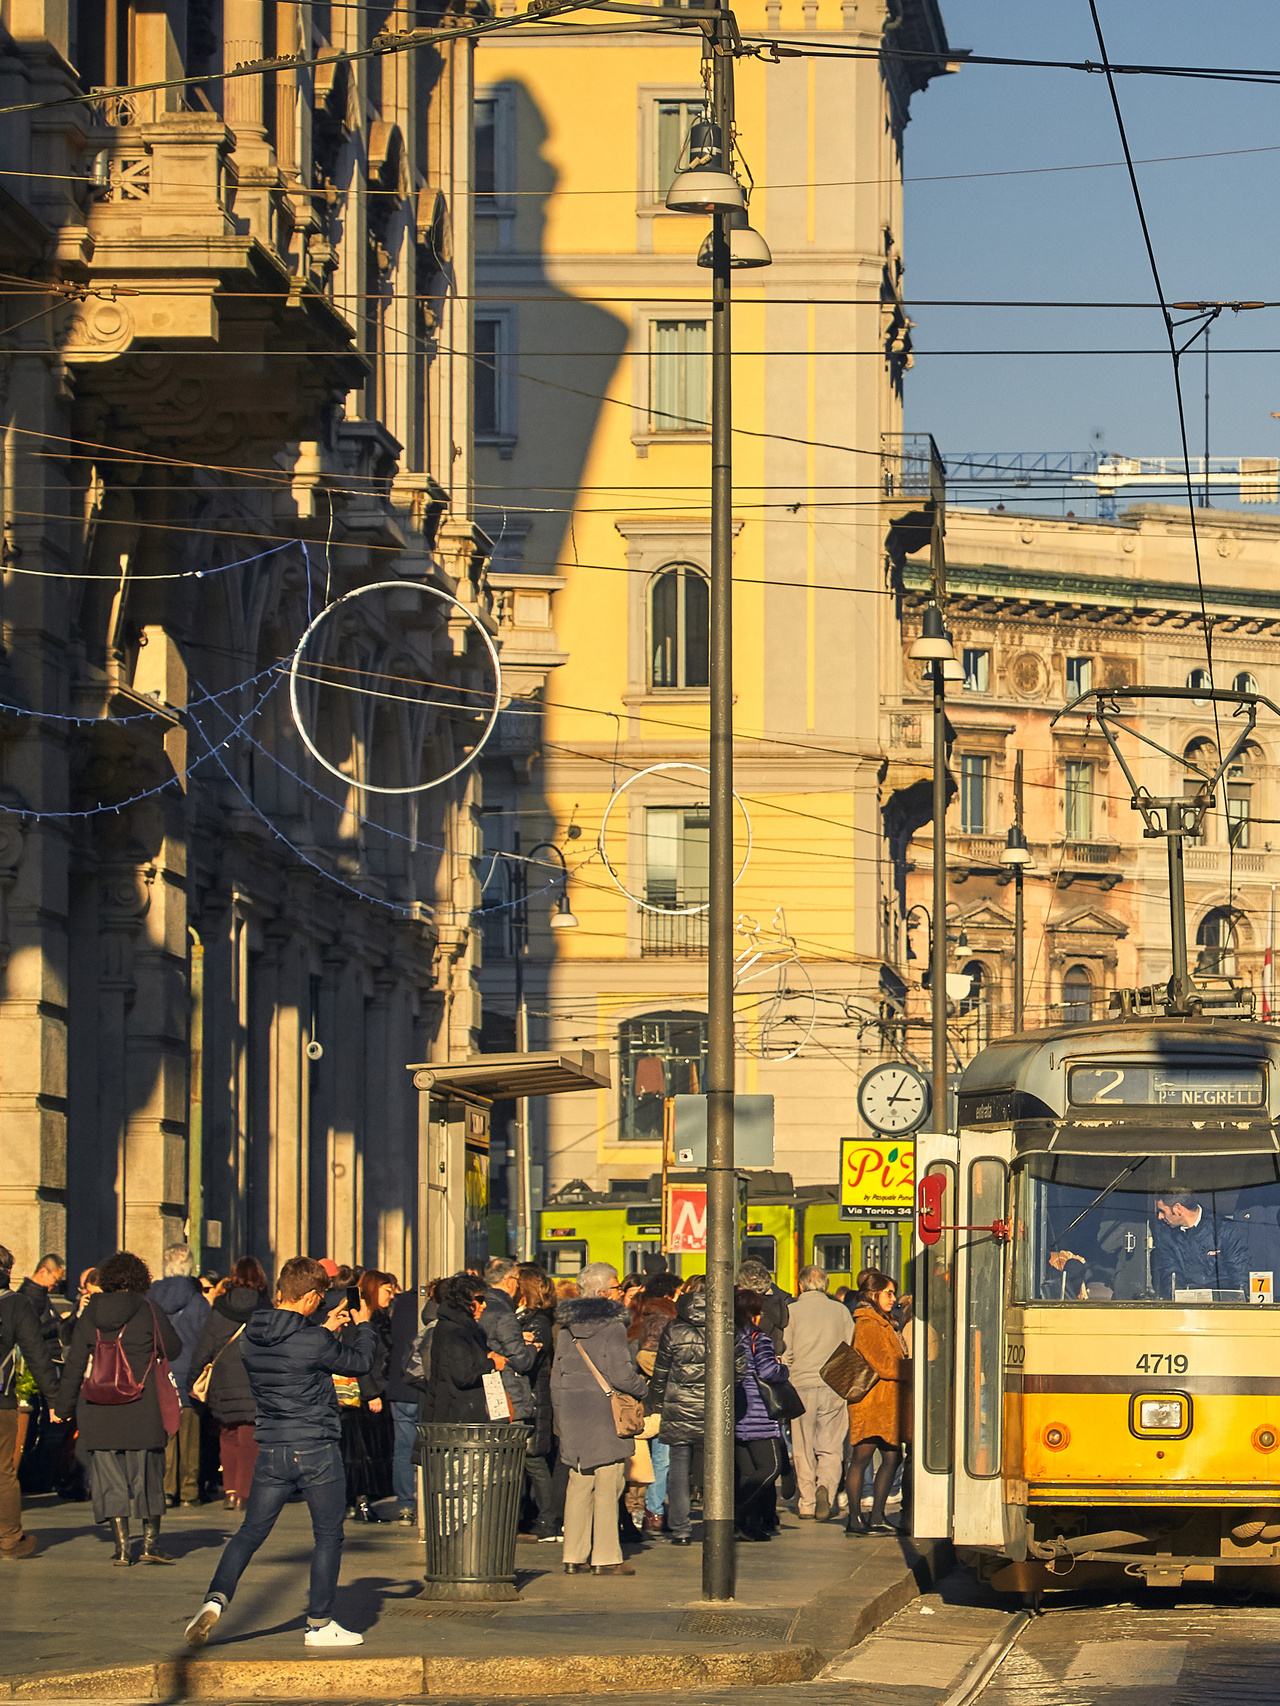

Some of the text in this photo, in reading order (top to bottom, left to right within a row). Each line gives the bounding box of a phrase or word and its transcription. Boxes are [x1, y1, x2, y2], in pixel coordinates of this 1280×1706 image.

[1091, 1070, 1124, 1104] 2
[847, 1206, 912, 1216] Via Torino 34
[1257, 1279, 1265, 1292] 7
[1135, 1354, 1189, 1374] 4719
